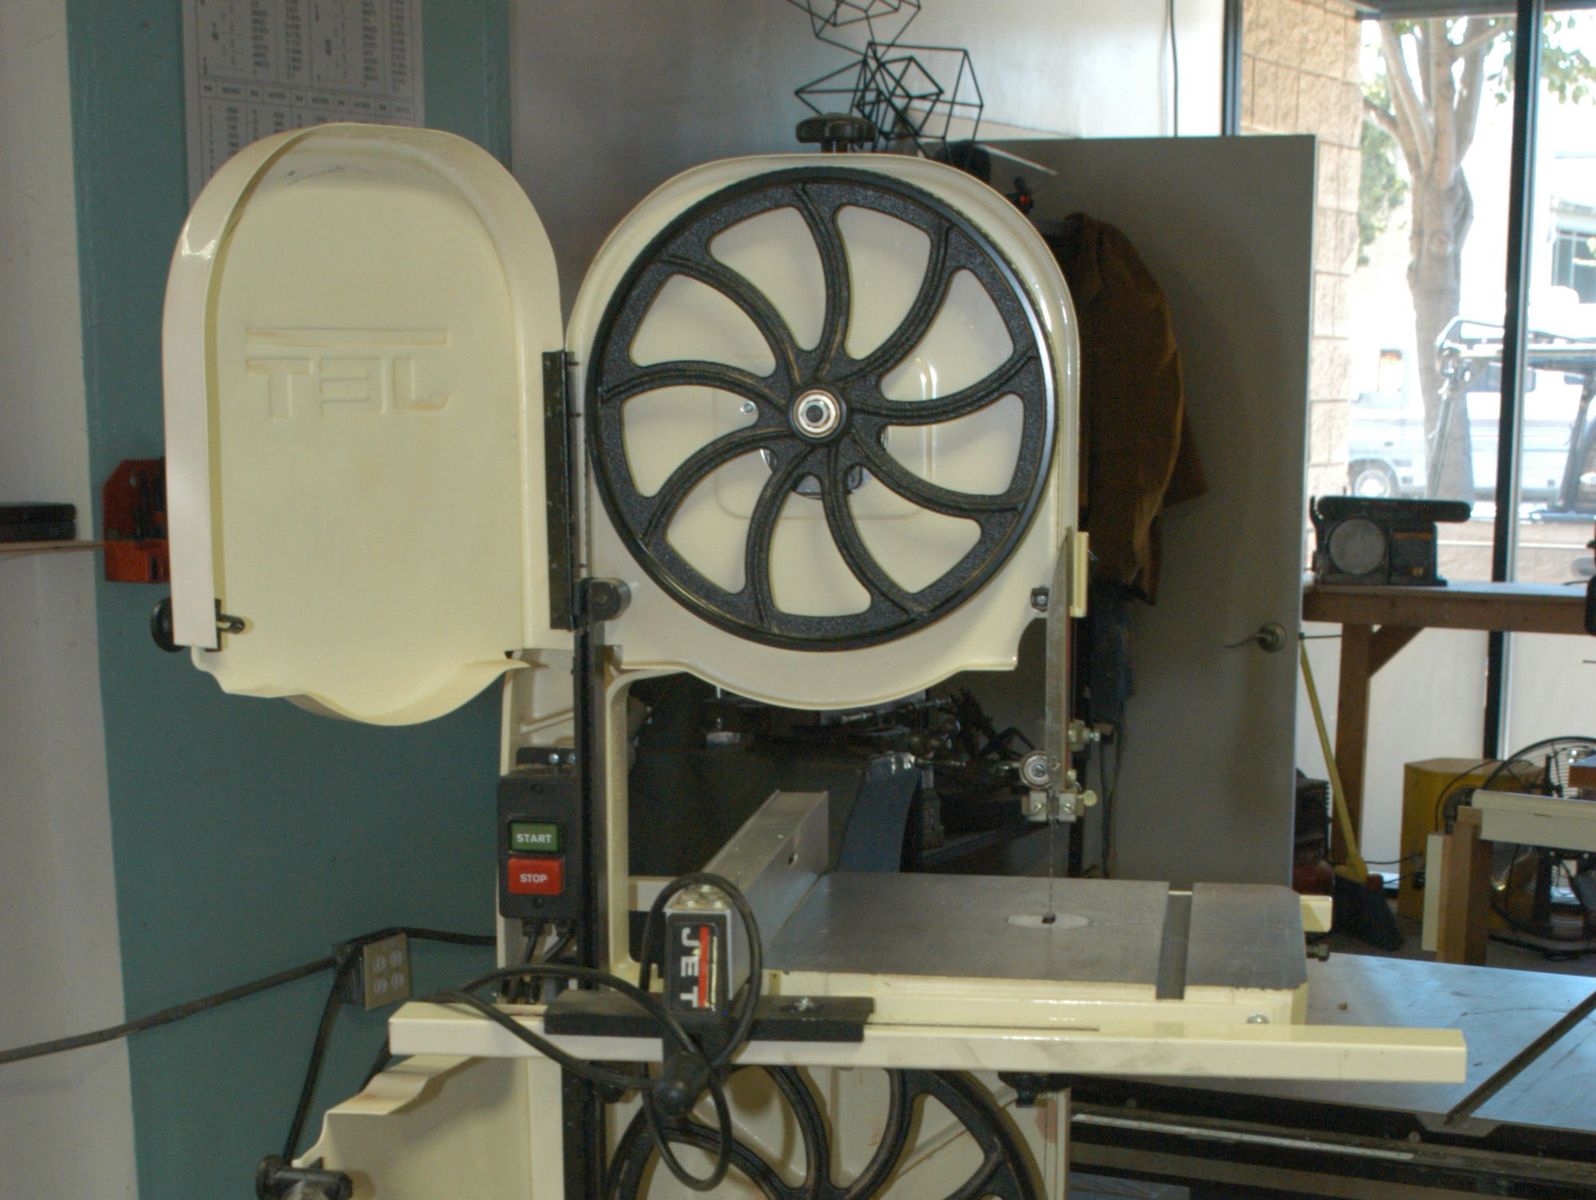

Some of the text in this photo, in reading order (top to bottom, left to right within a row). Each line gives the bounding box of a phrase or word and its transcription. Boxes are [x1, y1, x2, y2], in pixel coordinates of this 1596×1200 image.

[515, 833, 553, 843] START
[519, 873, 549, 883] STOP
[680, 927, 701, 1008] JET
